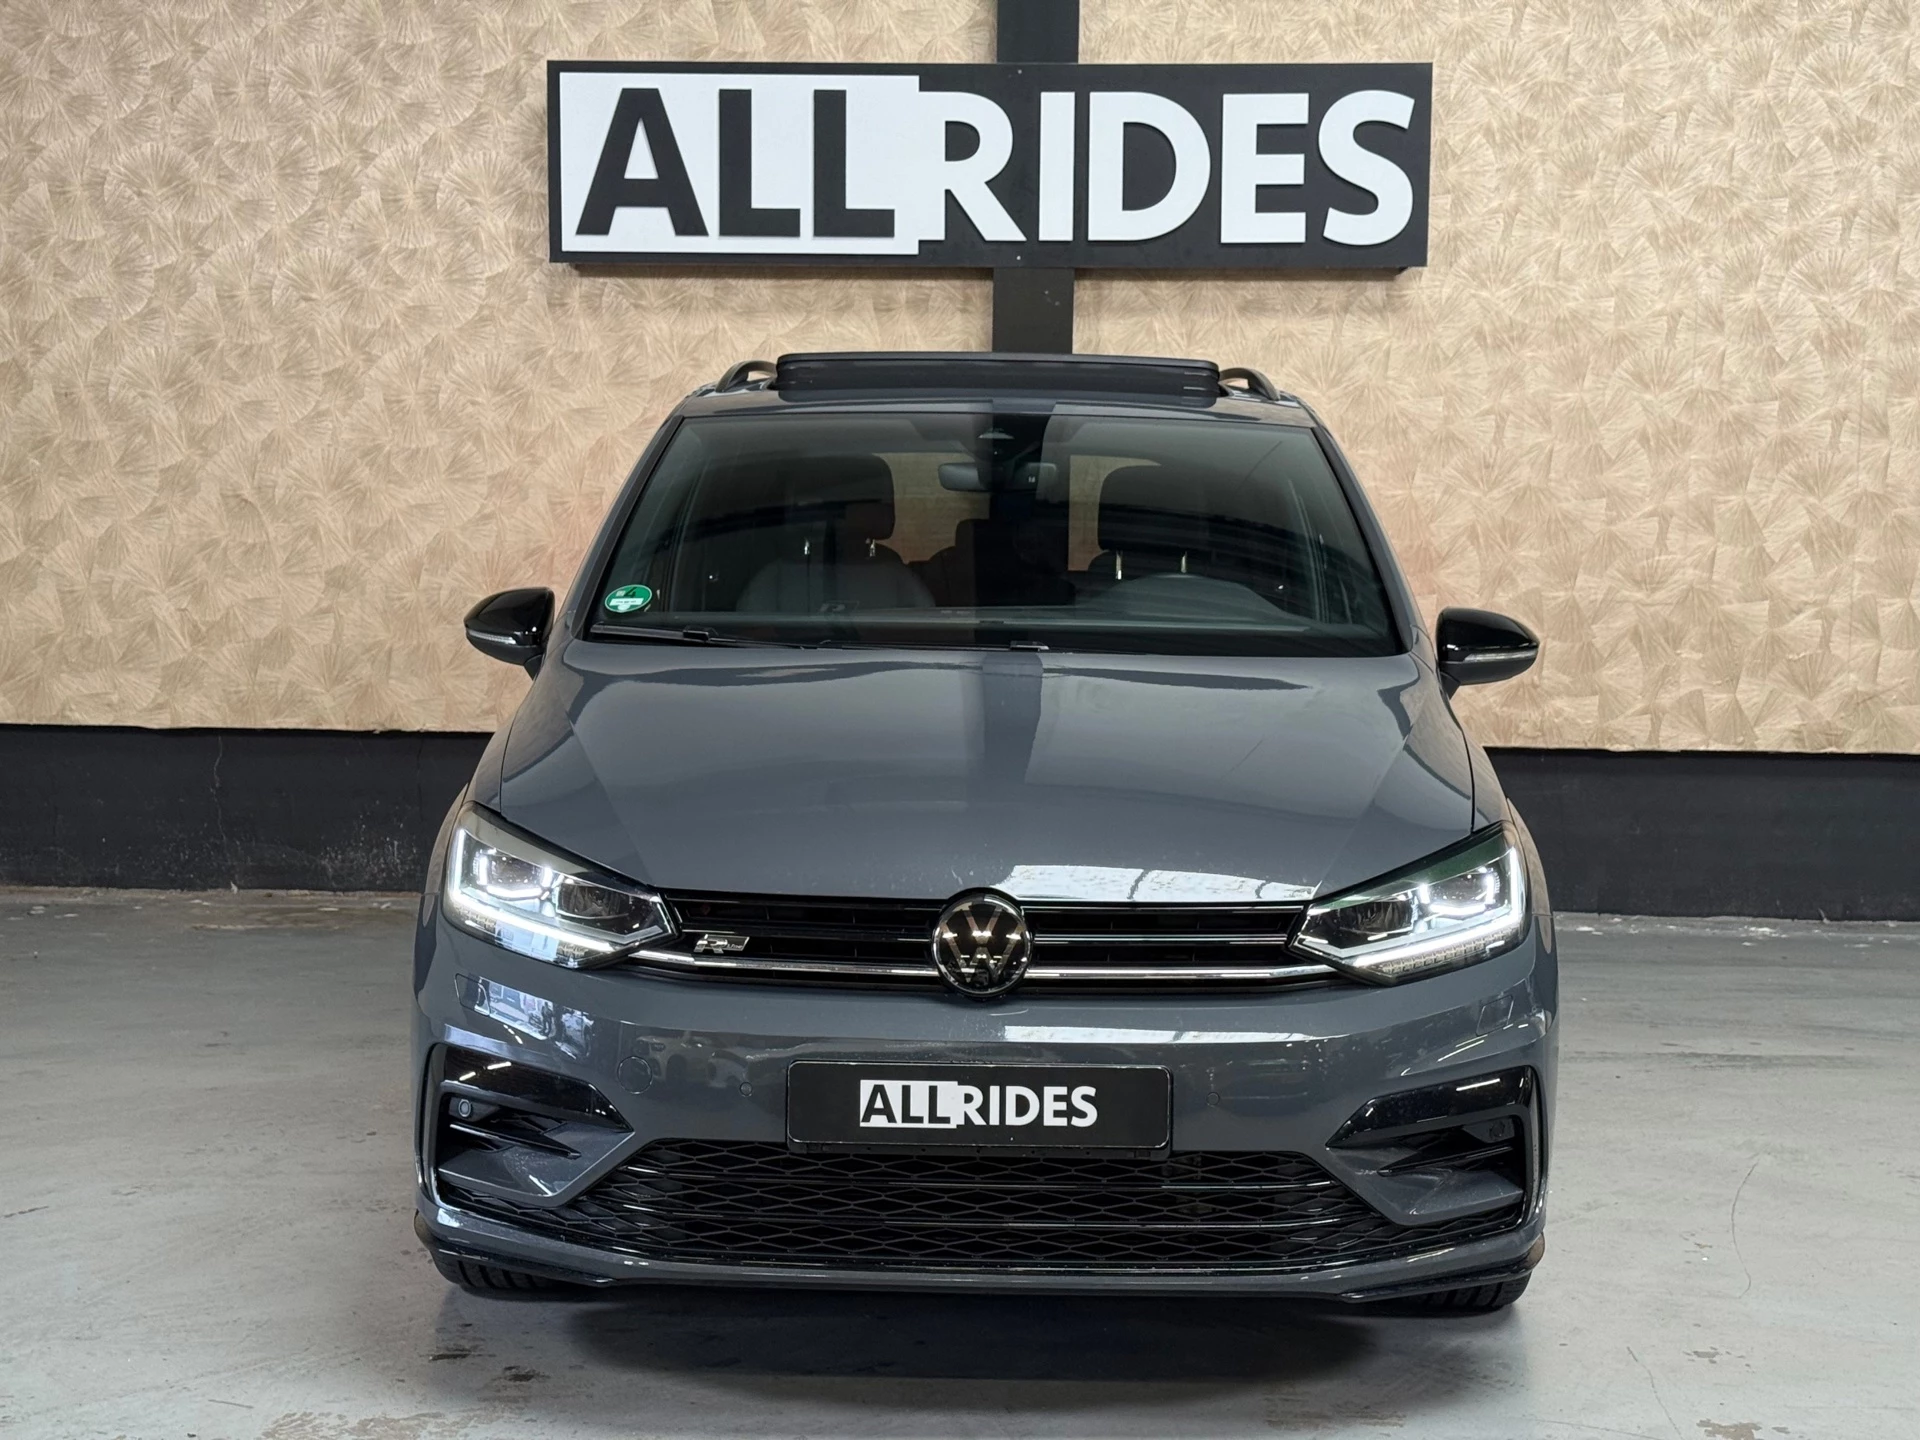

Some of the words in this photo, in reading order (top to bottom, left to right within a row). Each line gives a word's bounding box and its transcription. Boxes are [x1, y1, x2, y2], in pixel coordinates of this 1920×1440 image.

[575, 87, 1415, 246] ALLRIDES
[624, 587, 638, 598] 4
[861, 1084, 1098, 1127] ALLRIDES
